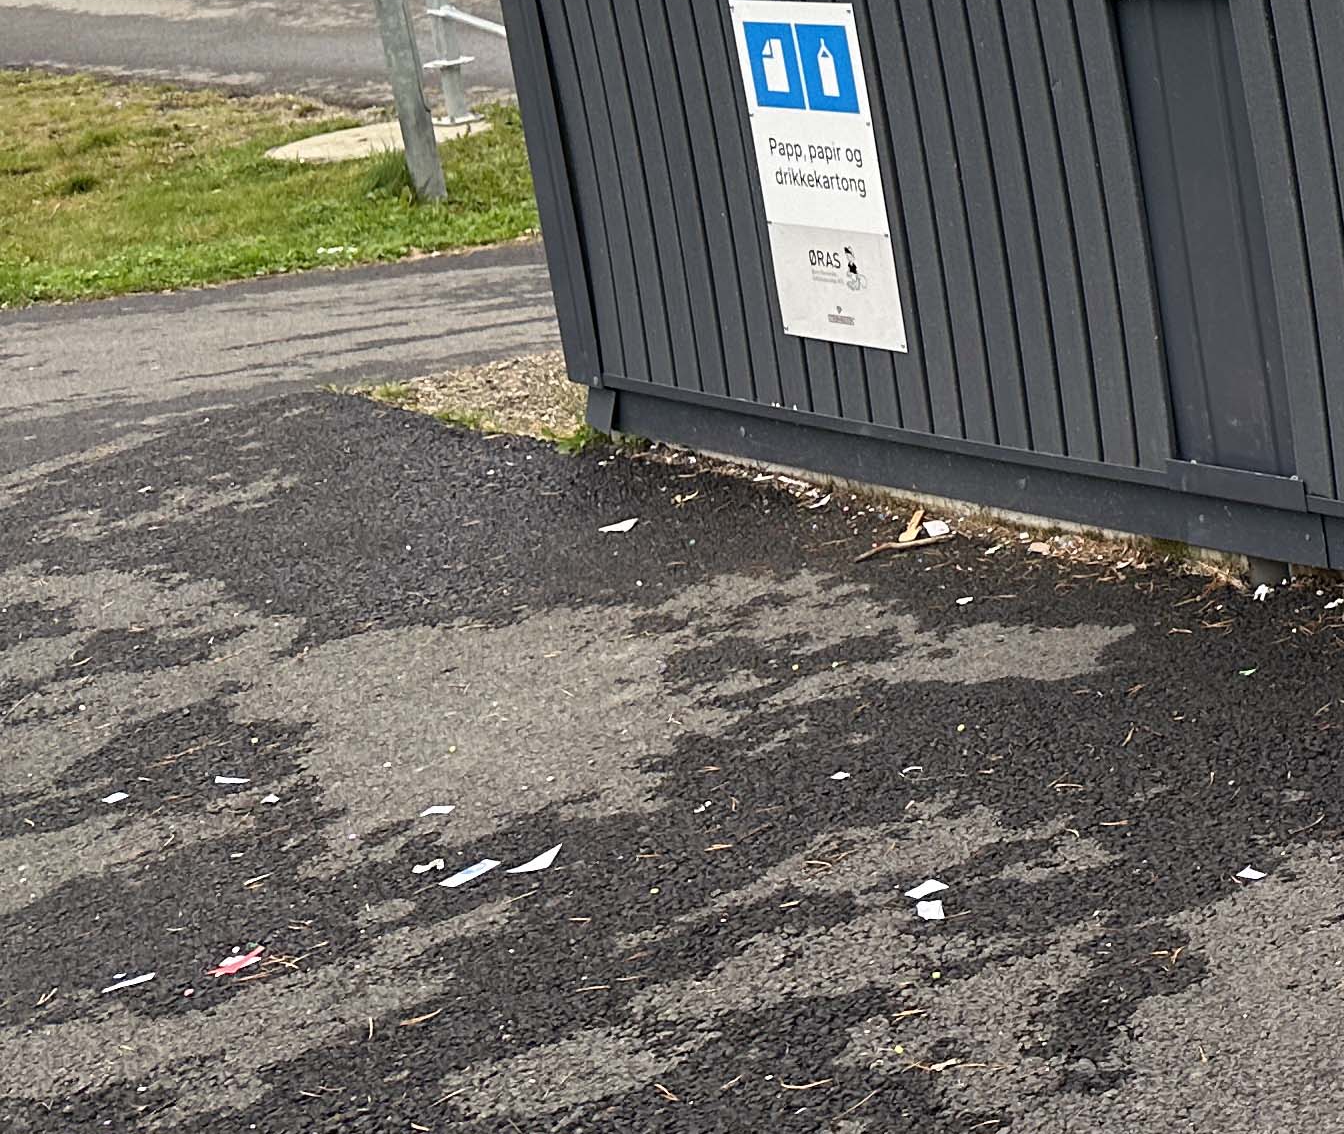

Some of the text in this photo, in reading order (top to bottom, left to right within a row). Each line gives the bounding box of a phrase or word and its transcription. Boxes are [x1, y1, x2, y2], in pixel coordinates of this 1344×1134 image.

[768, 137, 863, 168] Papp, papir og
[775, 166, 867, 198] drikkekartong
[808, 249, 841, 269] ØRAS
